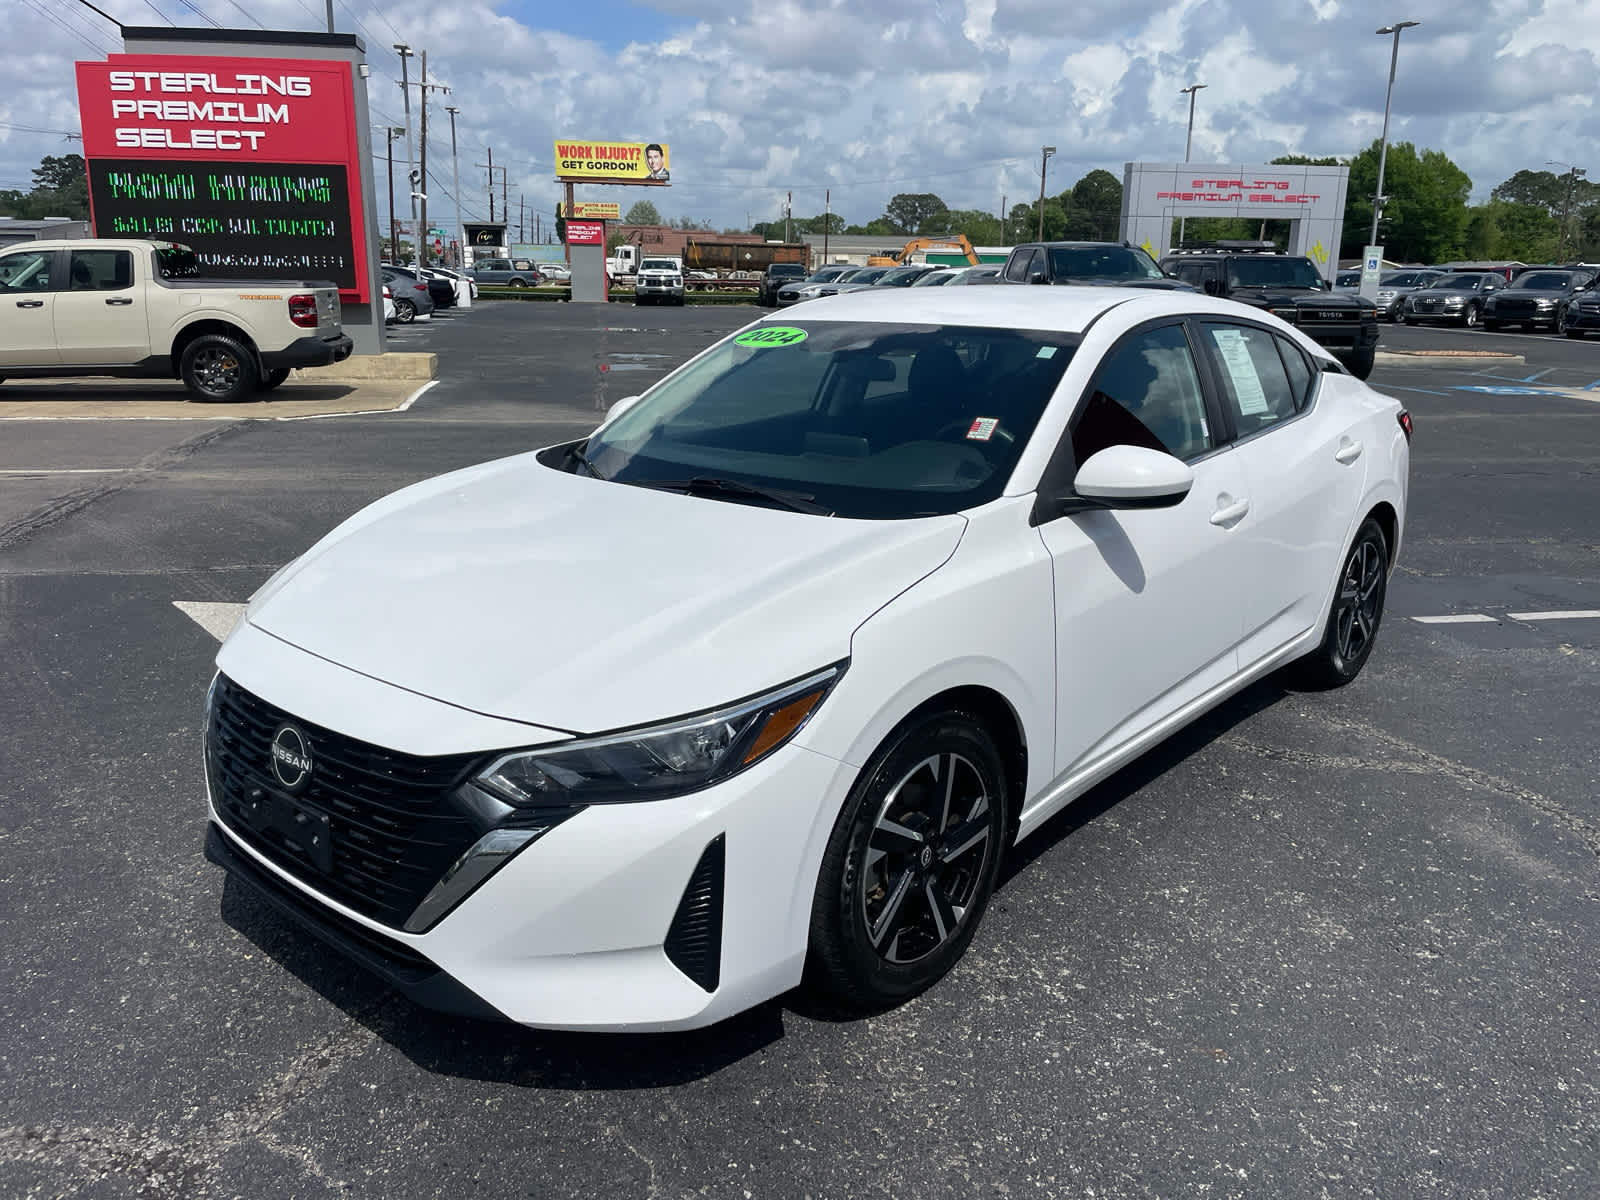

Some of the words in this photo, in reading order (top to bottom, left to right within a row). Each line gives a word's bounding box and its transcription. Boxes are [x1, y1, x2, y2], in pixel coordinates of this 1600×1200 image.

[109, 71, 311, 96] STERLING
[112, 99, 289, 123] PREMIUM
[115, 128, 265, 150] SELECT
[558, 145, 592, 160] WORK
[595, 146, 641, 160] INJURY?
[562, 161, 584, 169] GET
[586, 162, 637, 171] GORDON!
[1192, 179, 1289, 190] STERLING
[1157, 192, 1243, 201] PREMIUM
[1248, 194, 1320, 203] SELECT
[737, 331, 804, 343] 2024
[272, 742, 310, 771] NISSAN
